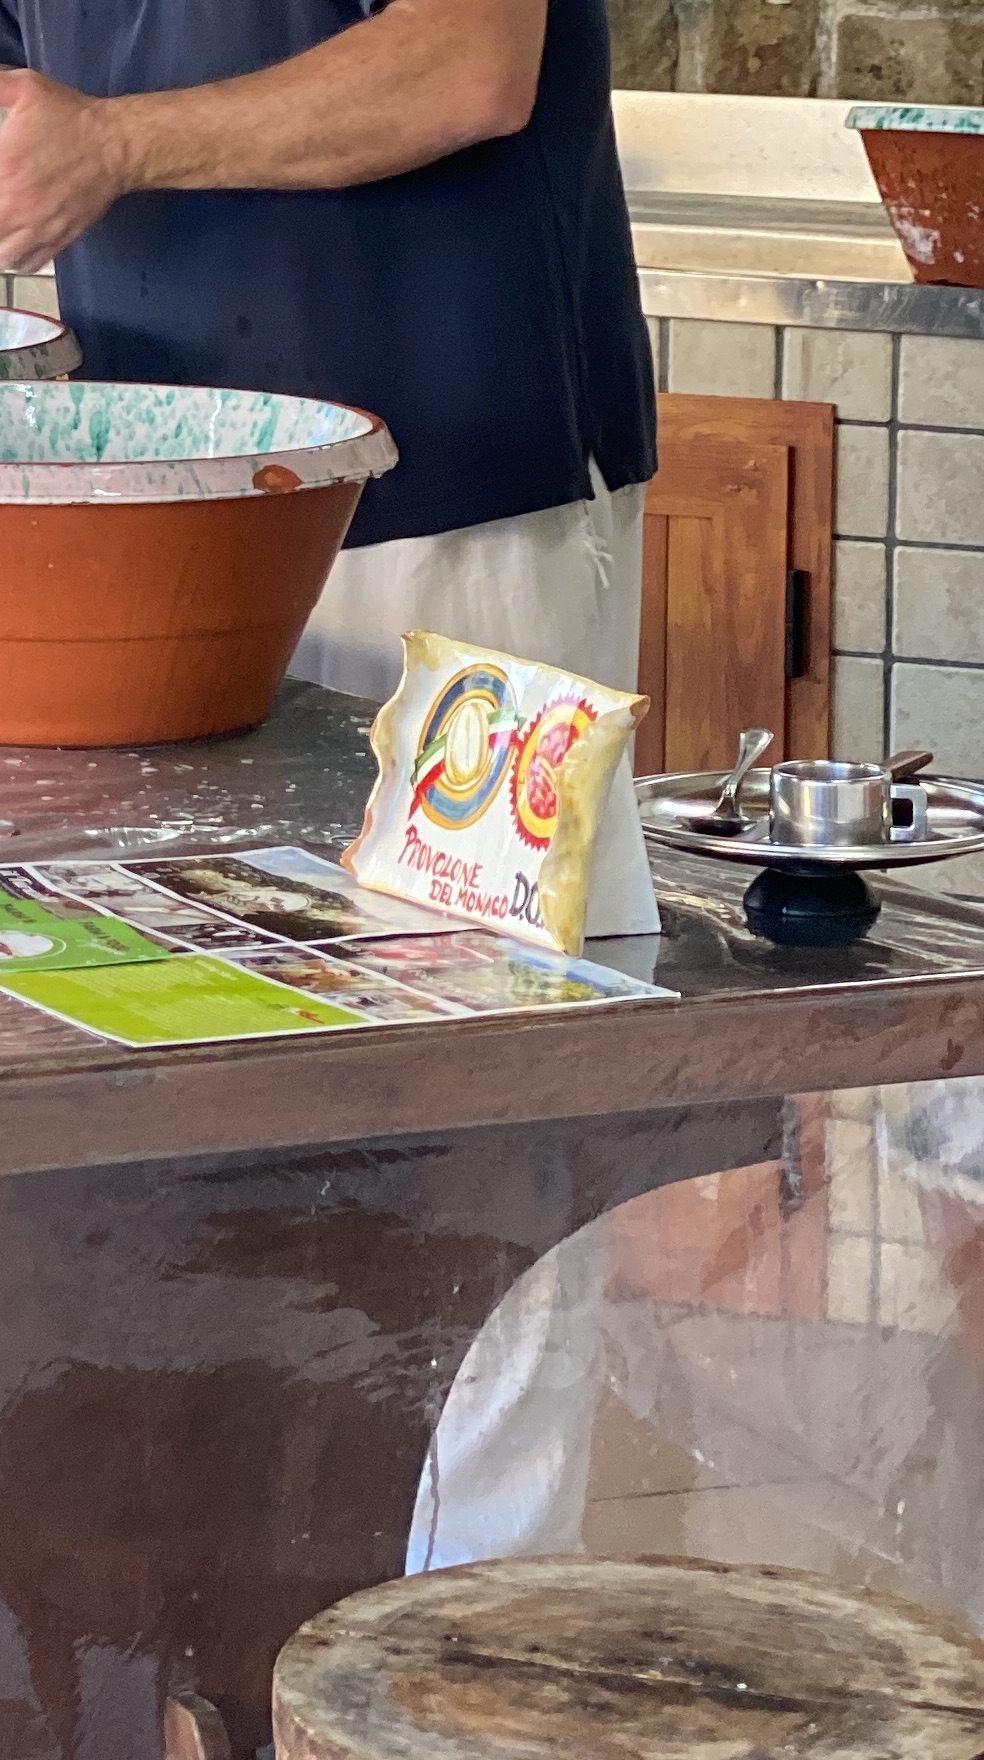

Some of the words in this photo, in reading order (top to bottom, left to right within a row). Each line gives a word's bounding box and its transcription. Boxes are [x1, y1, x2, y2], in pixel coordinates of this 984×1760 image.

[397, 824, 483, 888] PROVOLONE
[428, 879, 453, 906] DEL
[454, 886, 508, 919] MONACO
